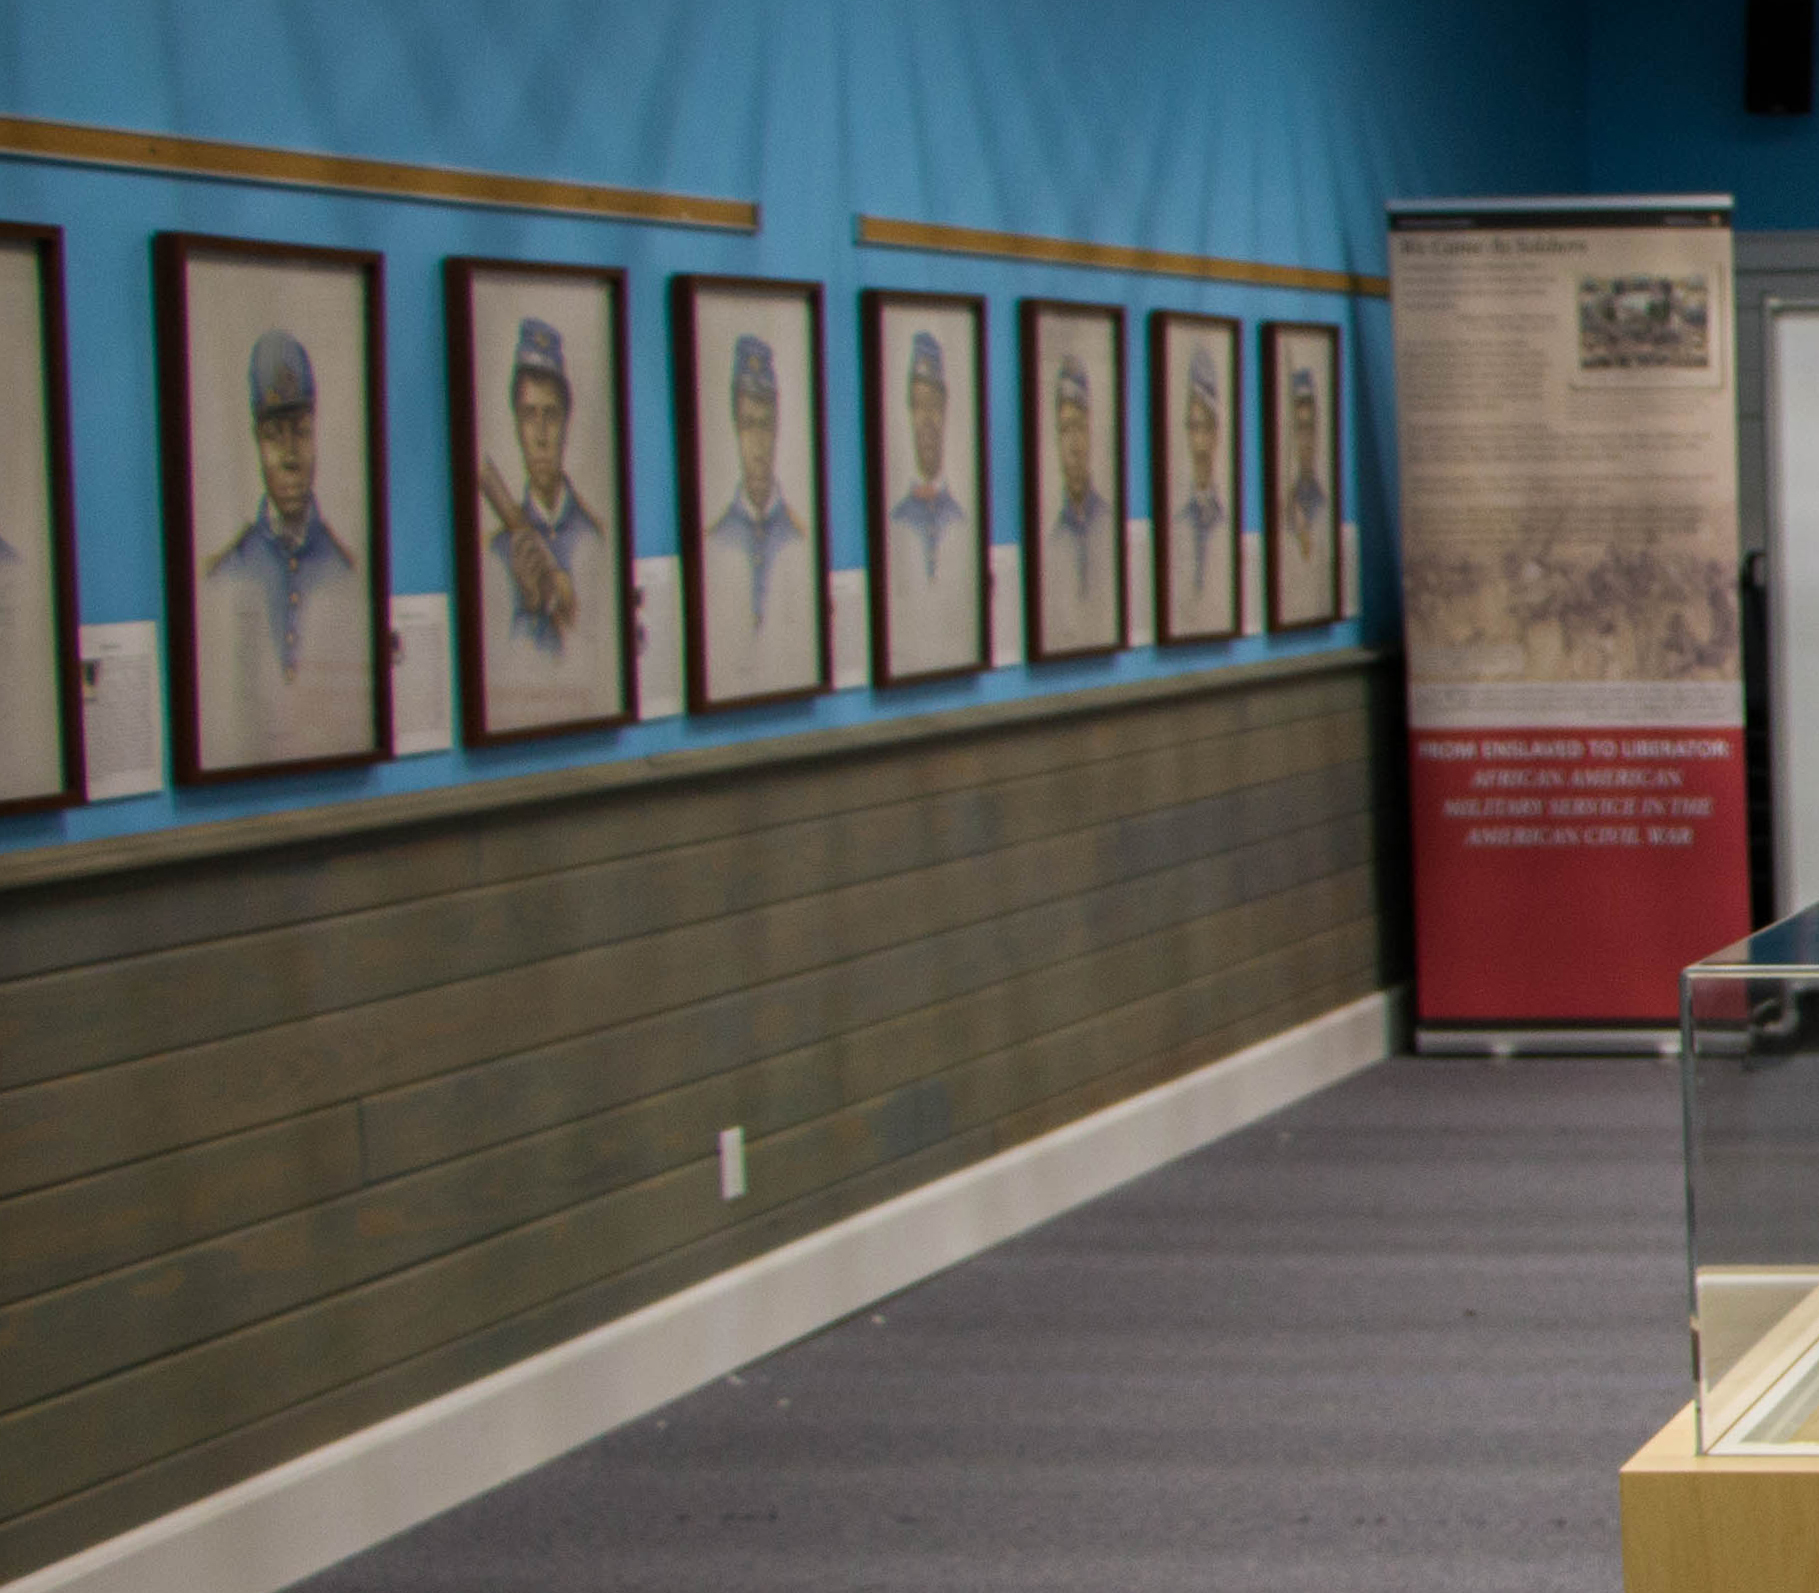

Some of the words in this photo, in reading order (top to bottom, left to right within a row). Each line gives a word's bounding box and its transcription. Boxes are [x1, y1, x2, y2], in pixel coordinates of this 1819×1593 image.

[1418, 741, 1475, 759] FROM
[1482, 741, 1584, 759] ENSLAVED
[1589, 741, 1615, 759] TO
[1471, 769, 1562, 788] AFRICAN
[1570, 769, 1684, 788] AMERICAN
[1443, 798, 1543, 817] MILITARY
[1549, 798, 1635, 817] SERVICE
[1641, 798, 1667, 817] IN
[1671, 798, 1714, 817] THE
[1465, 827, 1580, 846] AMERICAN
[1584, 827, 1640, 846] CIVIL
[1648, 827, 1694, 846] WAR
